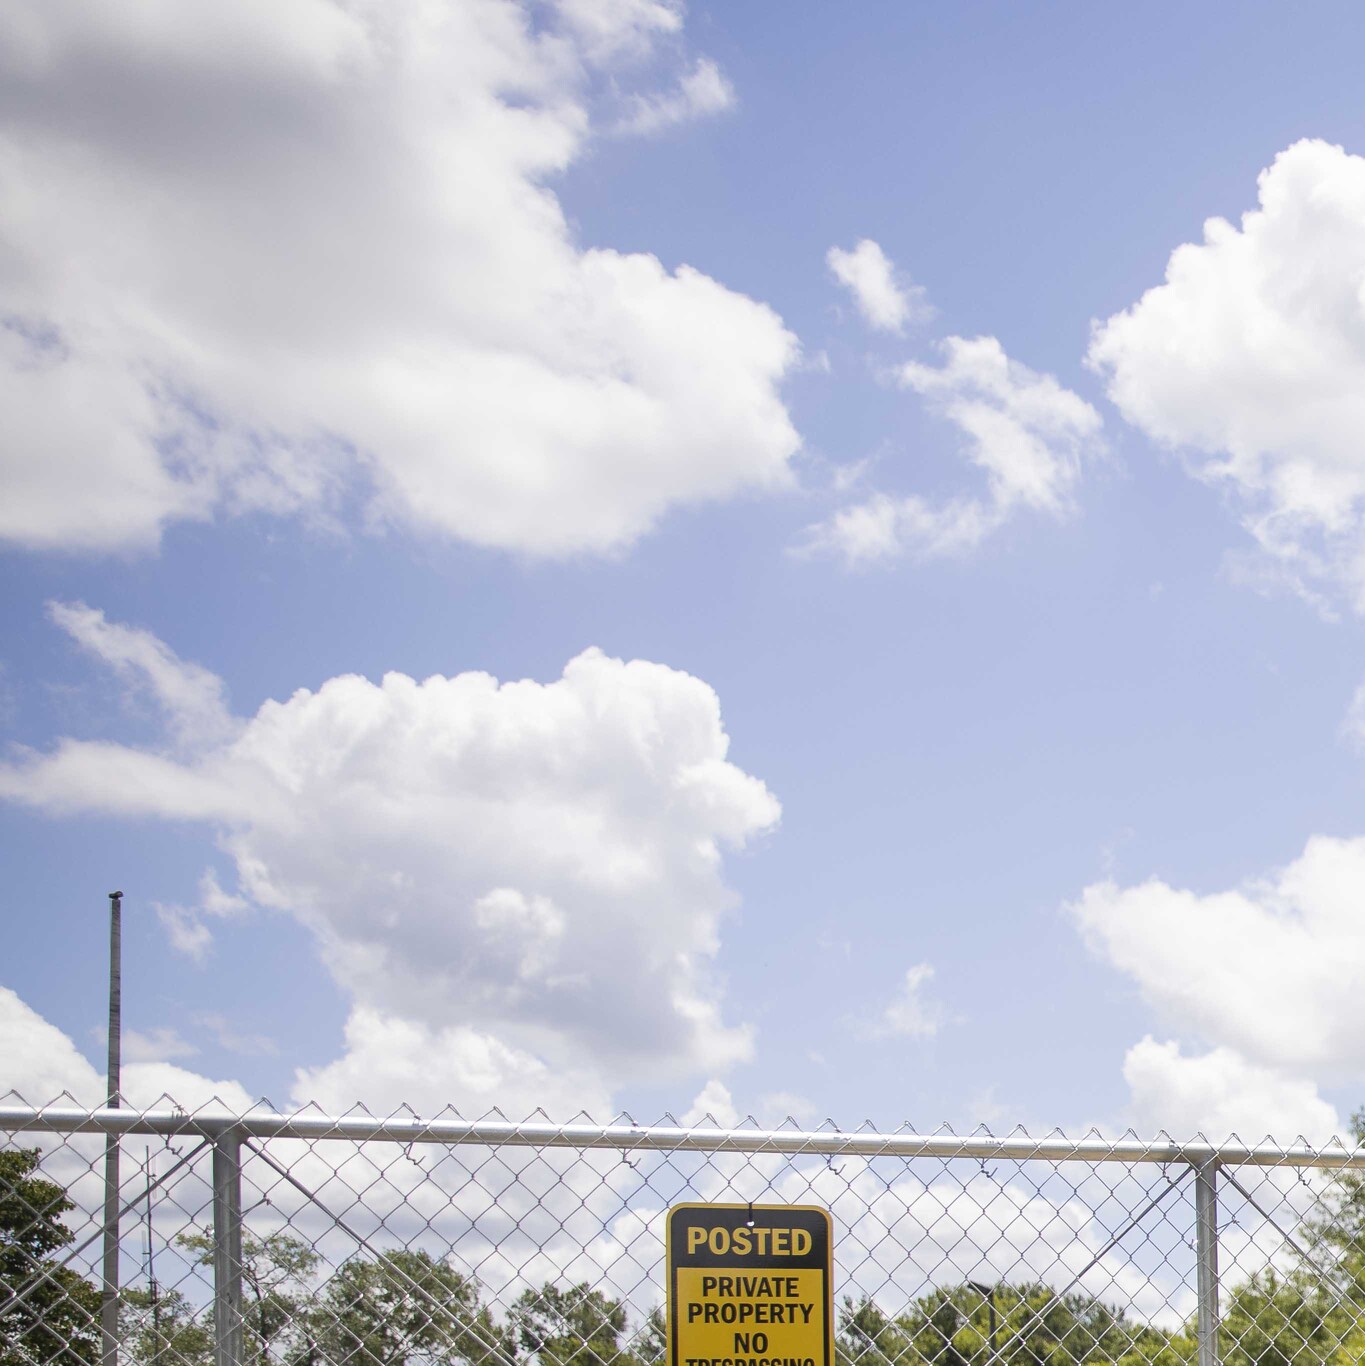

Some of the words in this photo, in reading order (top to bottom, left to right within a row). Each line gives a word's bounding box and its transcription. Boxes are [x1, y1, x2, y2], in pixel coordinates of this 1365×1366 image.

[687, 1226, 813, 1256] POSTED
[702, 1276, 800, 1298] PRIVATE
[688, 1302, 815, 1324] PROPERTY
[734, 1332, 768, 1354] NO
